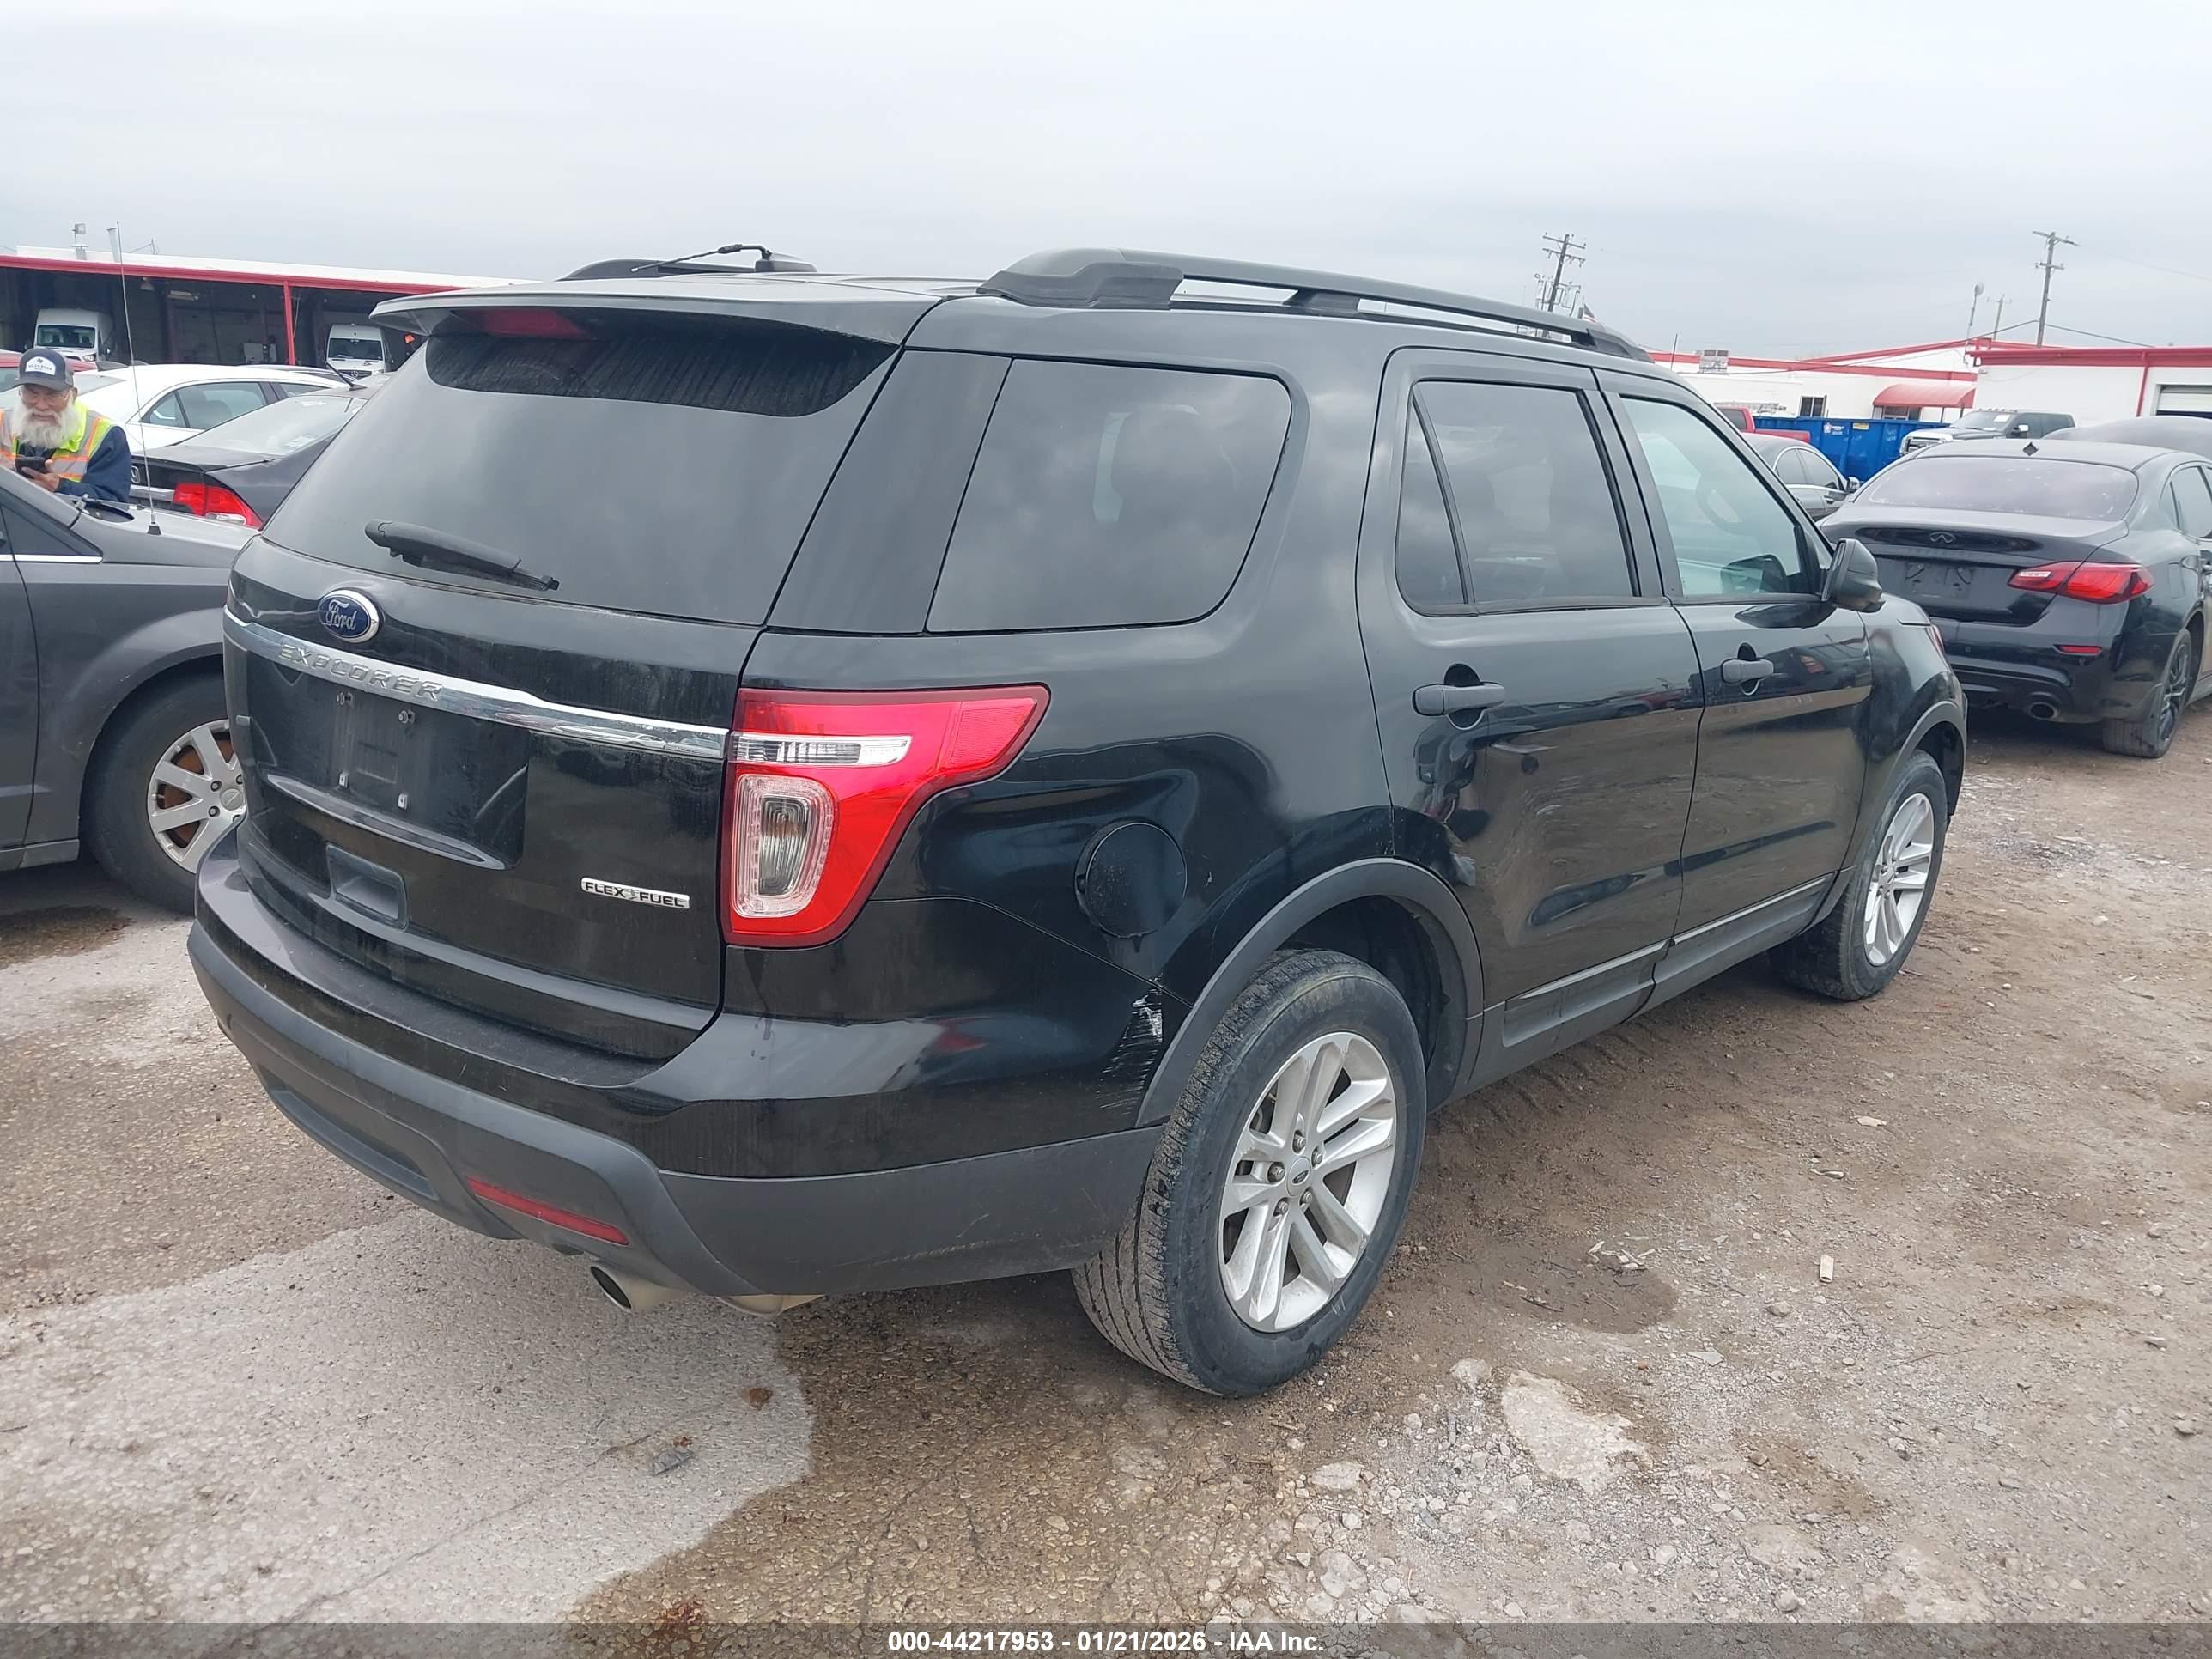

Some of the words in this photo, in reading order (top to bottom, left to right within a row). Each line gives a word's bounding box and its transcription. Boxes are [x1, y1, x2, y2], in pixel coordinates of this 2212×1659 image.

[325, 599, 357, 630] Ford
[279, 644, 443, 701] EXPLORER
[586, 882, 625, 898] FLEX
[639, 891, 685, 908] FUEL
